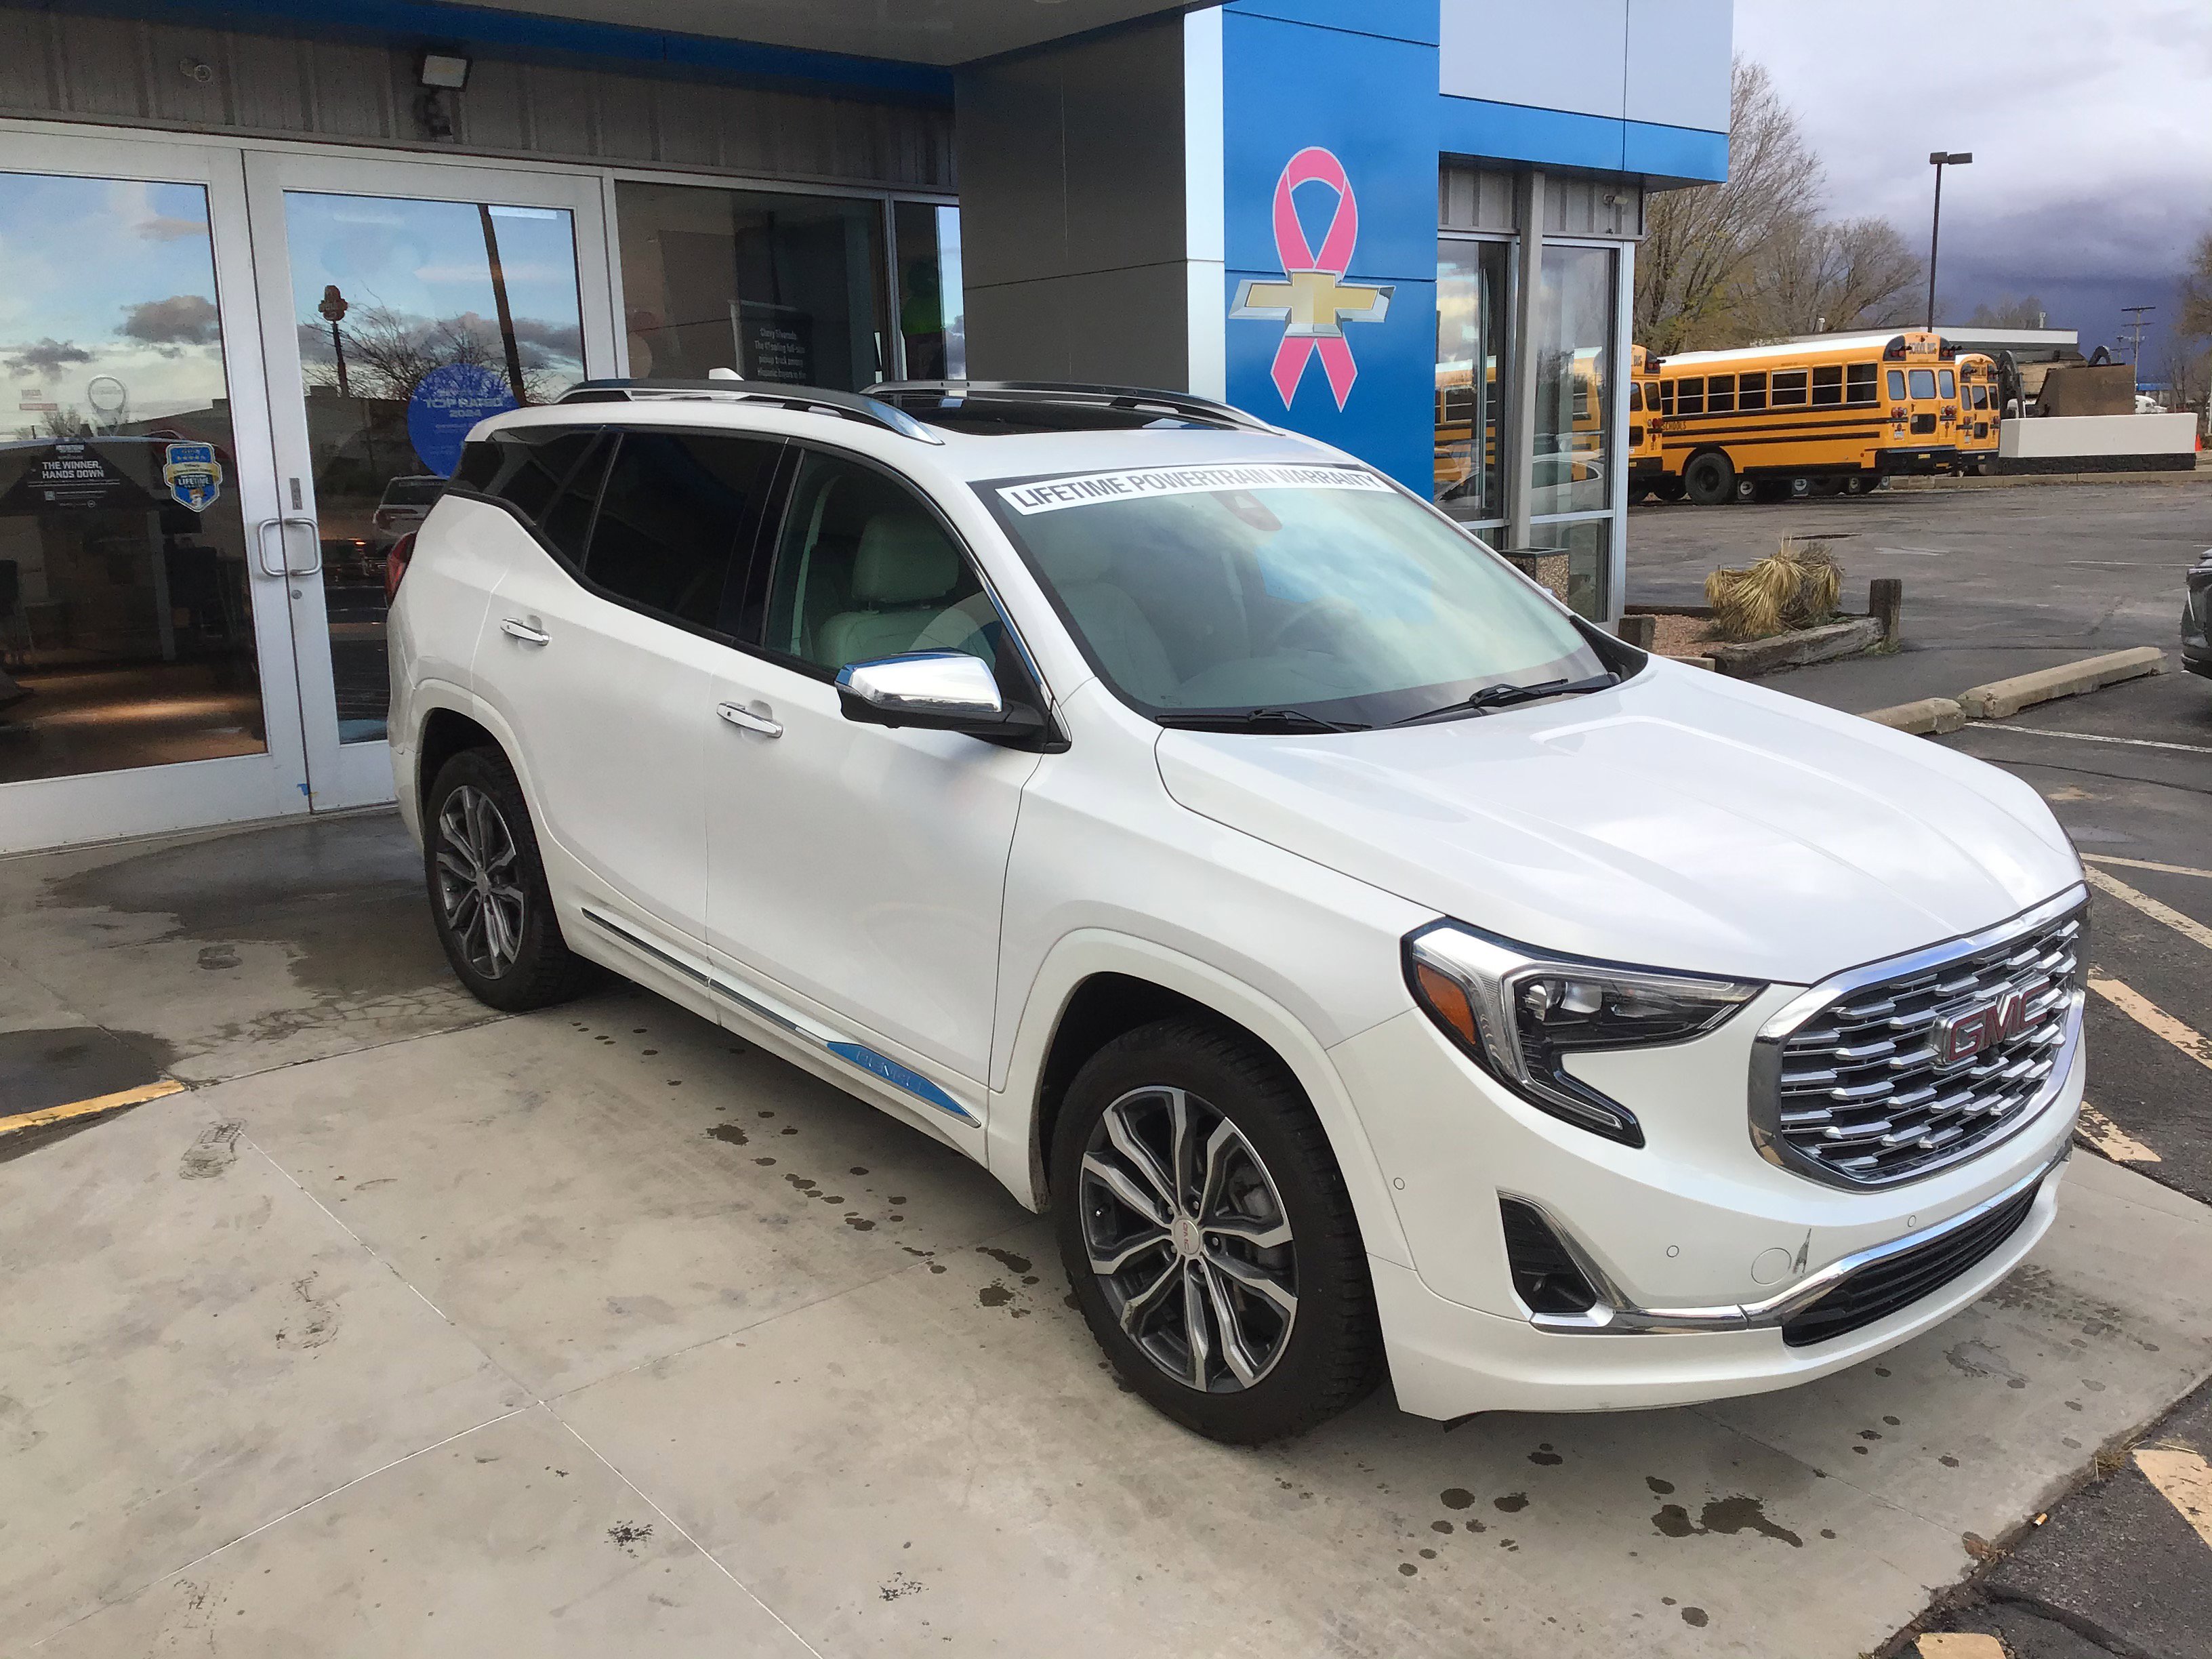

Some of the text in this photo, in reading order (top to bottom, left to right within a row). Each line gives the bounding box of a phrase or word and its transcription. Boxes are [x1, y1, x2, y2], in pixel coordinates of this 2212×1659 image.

[423, 398, 457, 408] TOP
[42, 460, 102, 470] THE WINNER,
[42, 470, 104, 479] HANDS DOWN
[178, 477, 210, 485] LIFETIME
[1010, 468, 1382, 508] LIFETIME POWERTRAIN WARRANTY
[1949, 977, 2050, 1062] GMC
